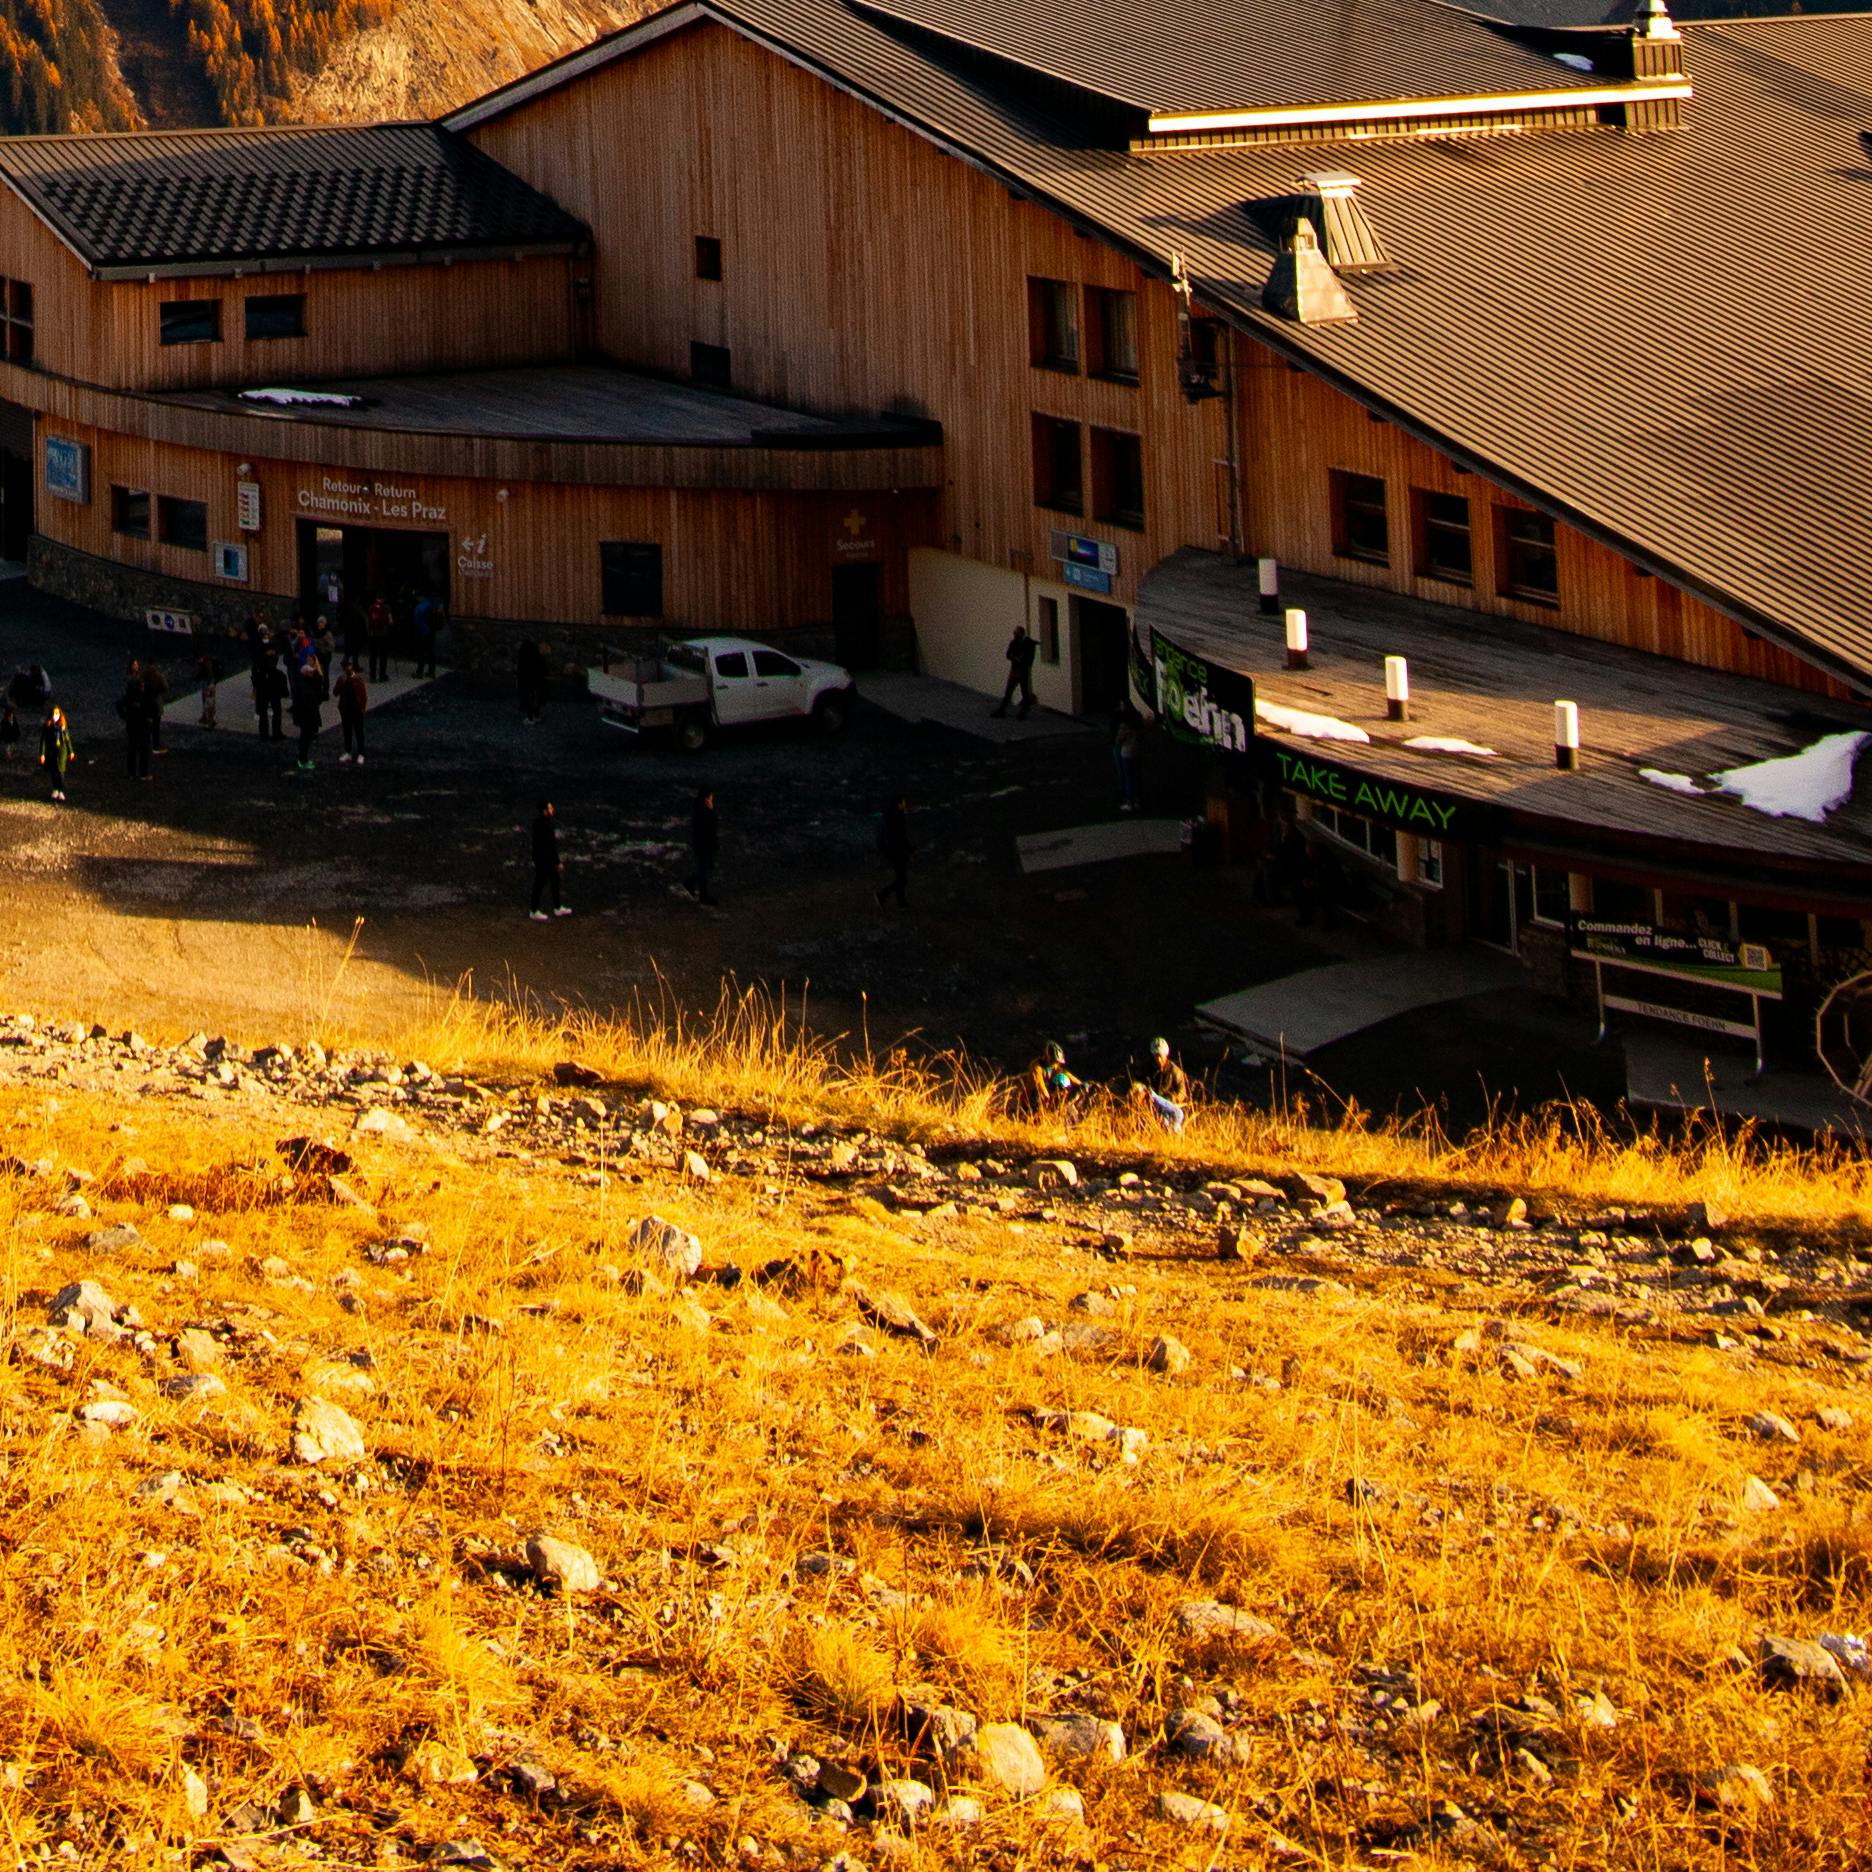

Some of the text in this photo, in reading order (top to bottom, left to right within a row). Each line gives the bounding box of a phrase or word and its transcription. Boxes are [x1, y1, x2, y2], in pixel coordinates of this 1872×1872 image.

[323, 476, 416, 498] Retour Return
[297, 489, 371, 514] Chamonix
[382, 499, 408, 518] Les
[412, 502, 447, 520] Praz
[1276, 752, 1457, 831] TAKE AWAY
[1577, 919, 1653, 936] Commandez
[1635, 935, 1652, 946] en
[1698, 937, 1722, 951] CLICK
[1702, 949, 1735, 964] COLLECT
[1637, 1003, 1727, 1032] TENDANCE FOEHN
